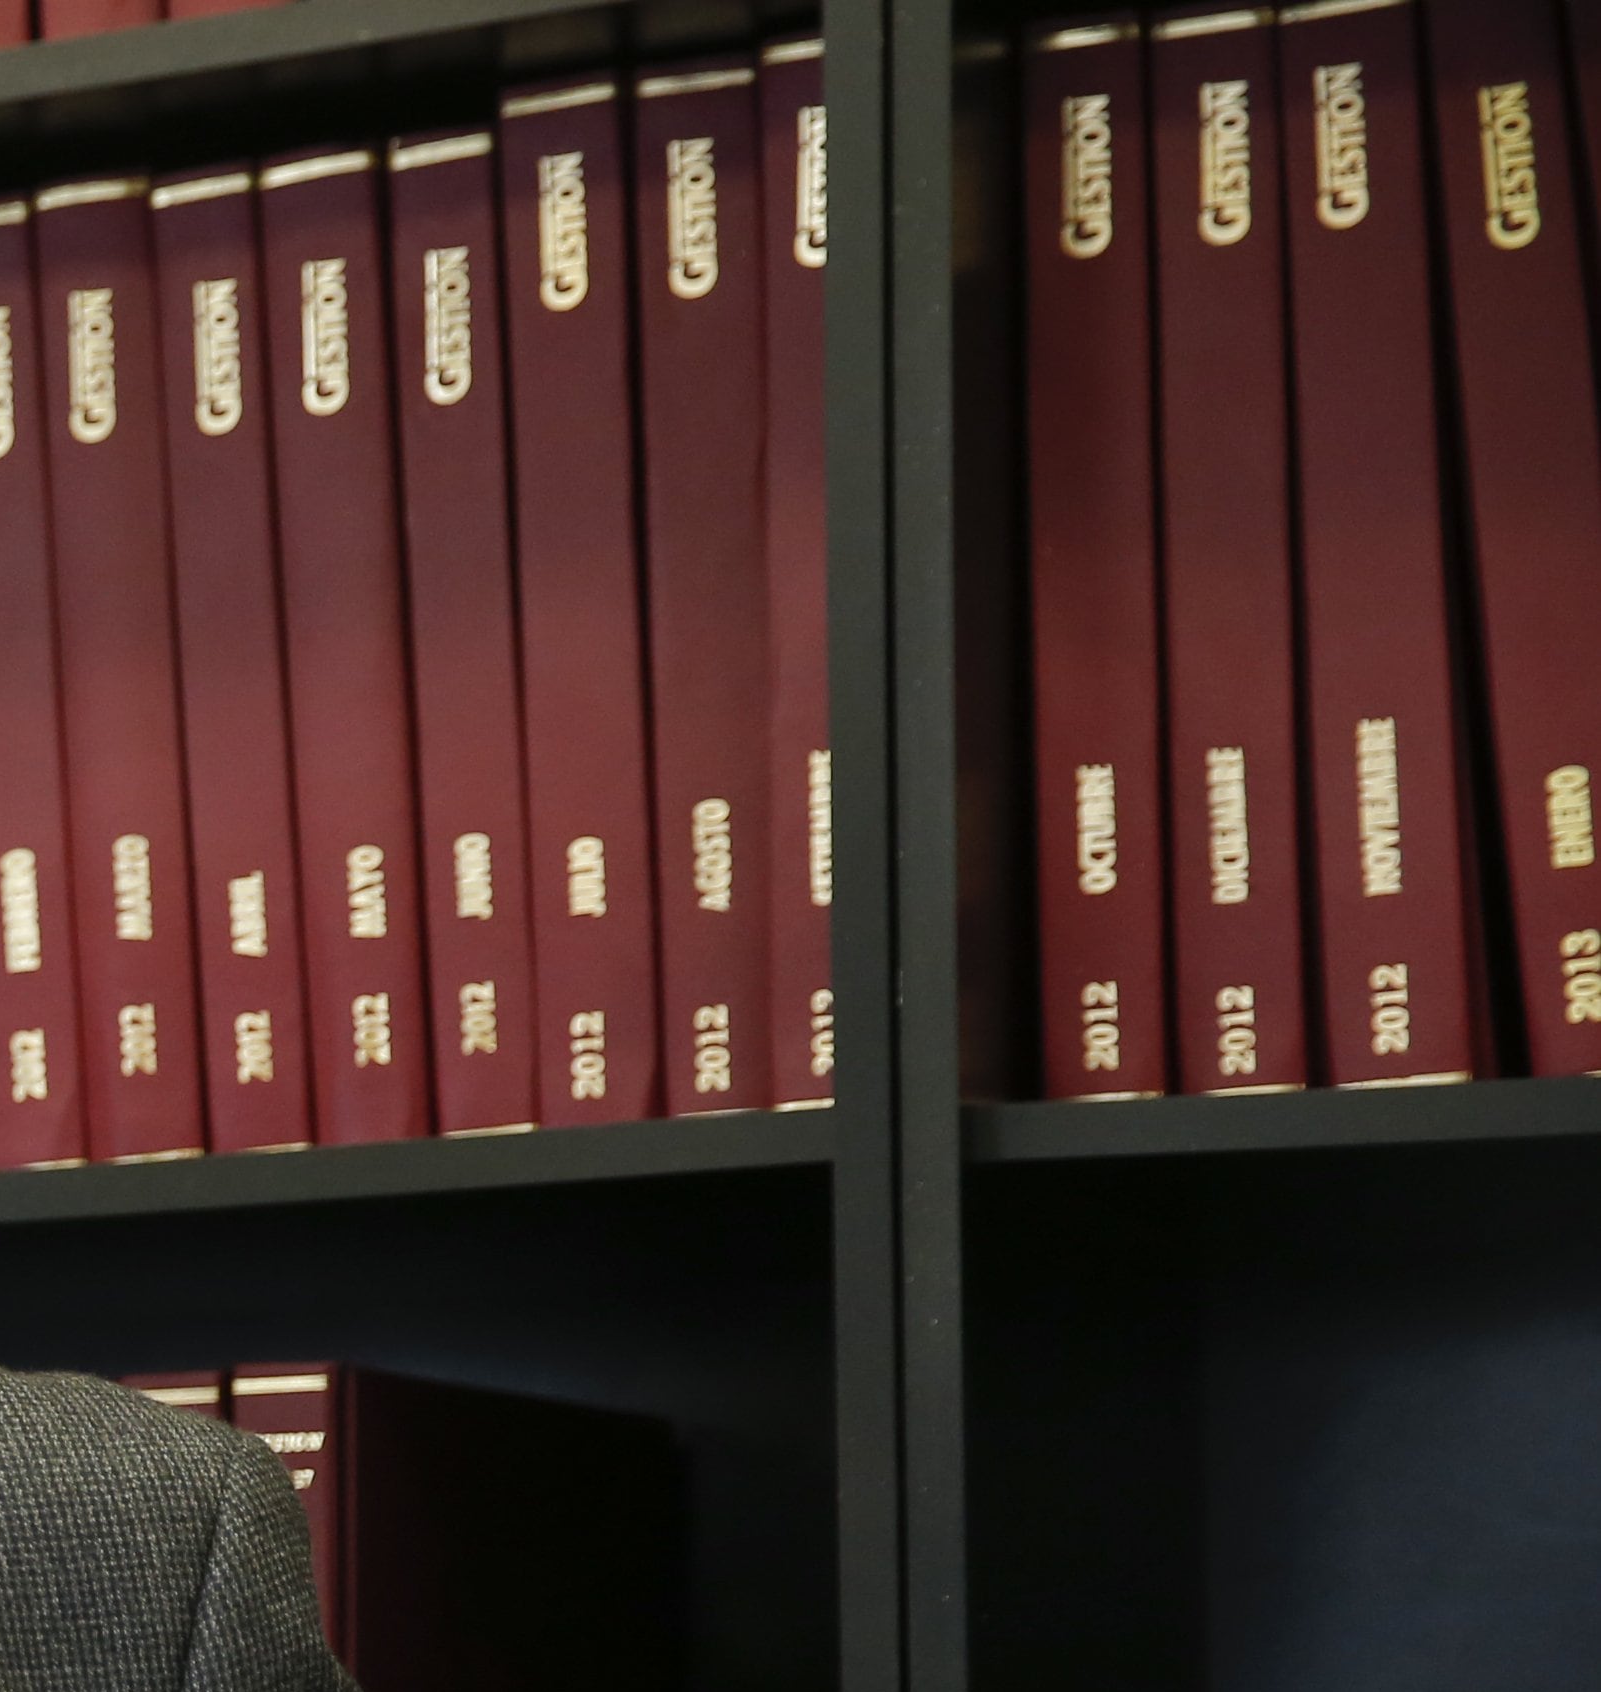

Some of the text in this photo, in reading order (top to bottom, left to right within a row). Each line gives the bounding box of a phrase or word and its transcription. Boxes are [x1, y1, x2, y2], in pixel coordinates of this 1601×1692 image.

[111, 834, 157, 1077] 2012 MARZO
[228, 870, 273, 1084] 2012 ABRIL
[346, 844, 392, 1067] 2012 MAYO
[453, 832, 498, 1055] 2012 JUNIO
[567, 836, 607, 1100] 2012 JULIO
[692, 798, 732, 1094] 2012 AGOSTO
[1077, 764, 1120, 1071] 2012 OCTUBRE
[1356, 716, 1410, 1055] 2012 NOVIEMBRE
[1546, 765, 1601, 1023] 2013 ENERO
[9, 1028, 48, 1103] 2012
[1216, 985, 1257, 1076] 2012
